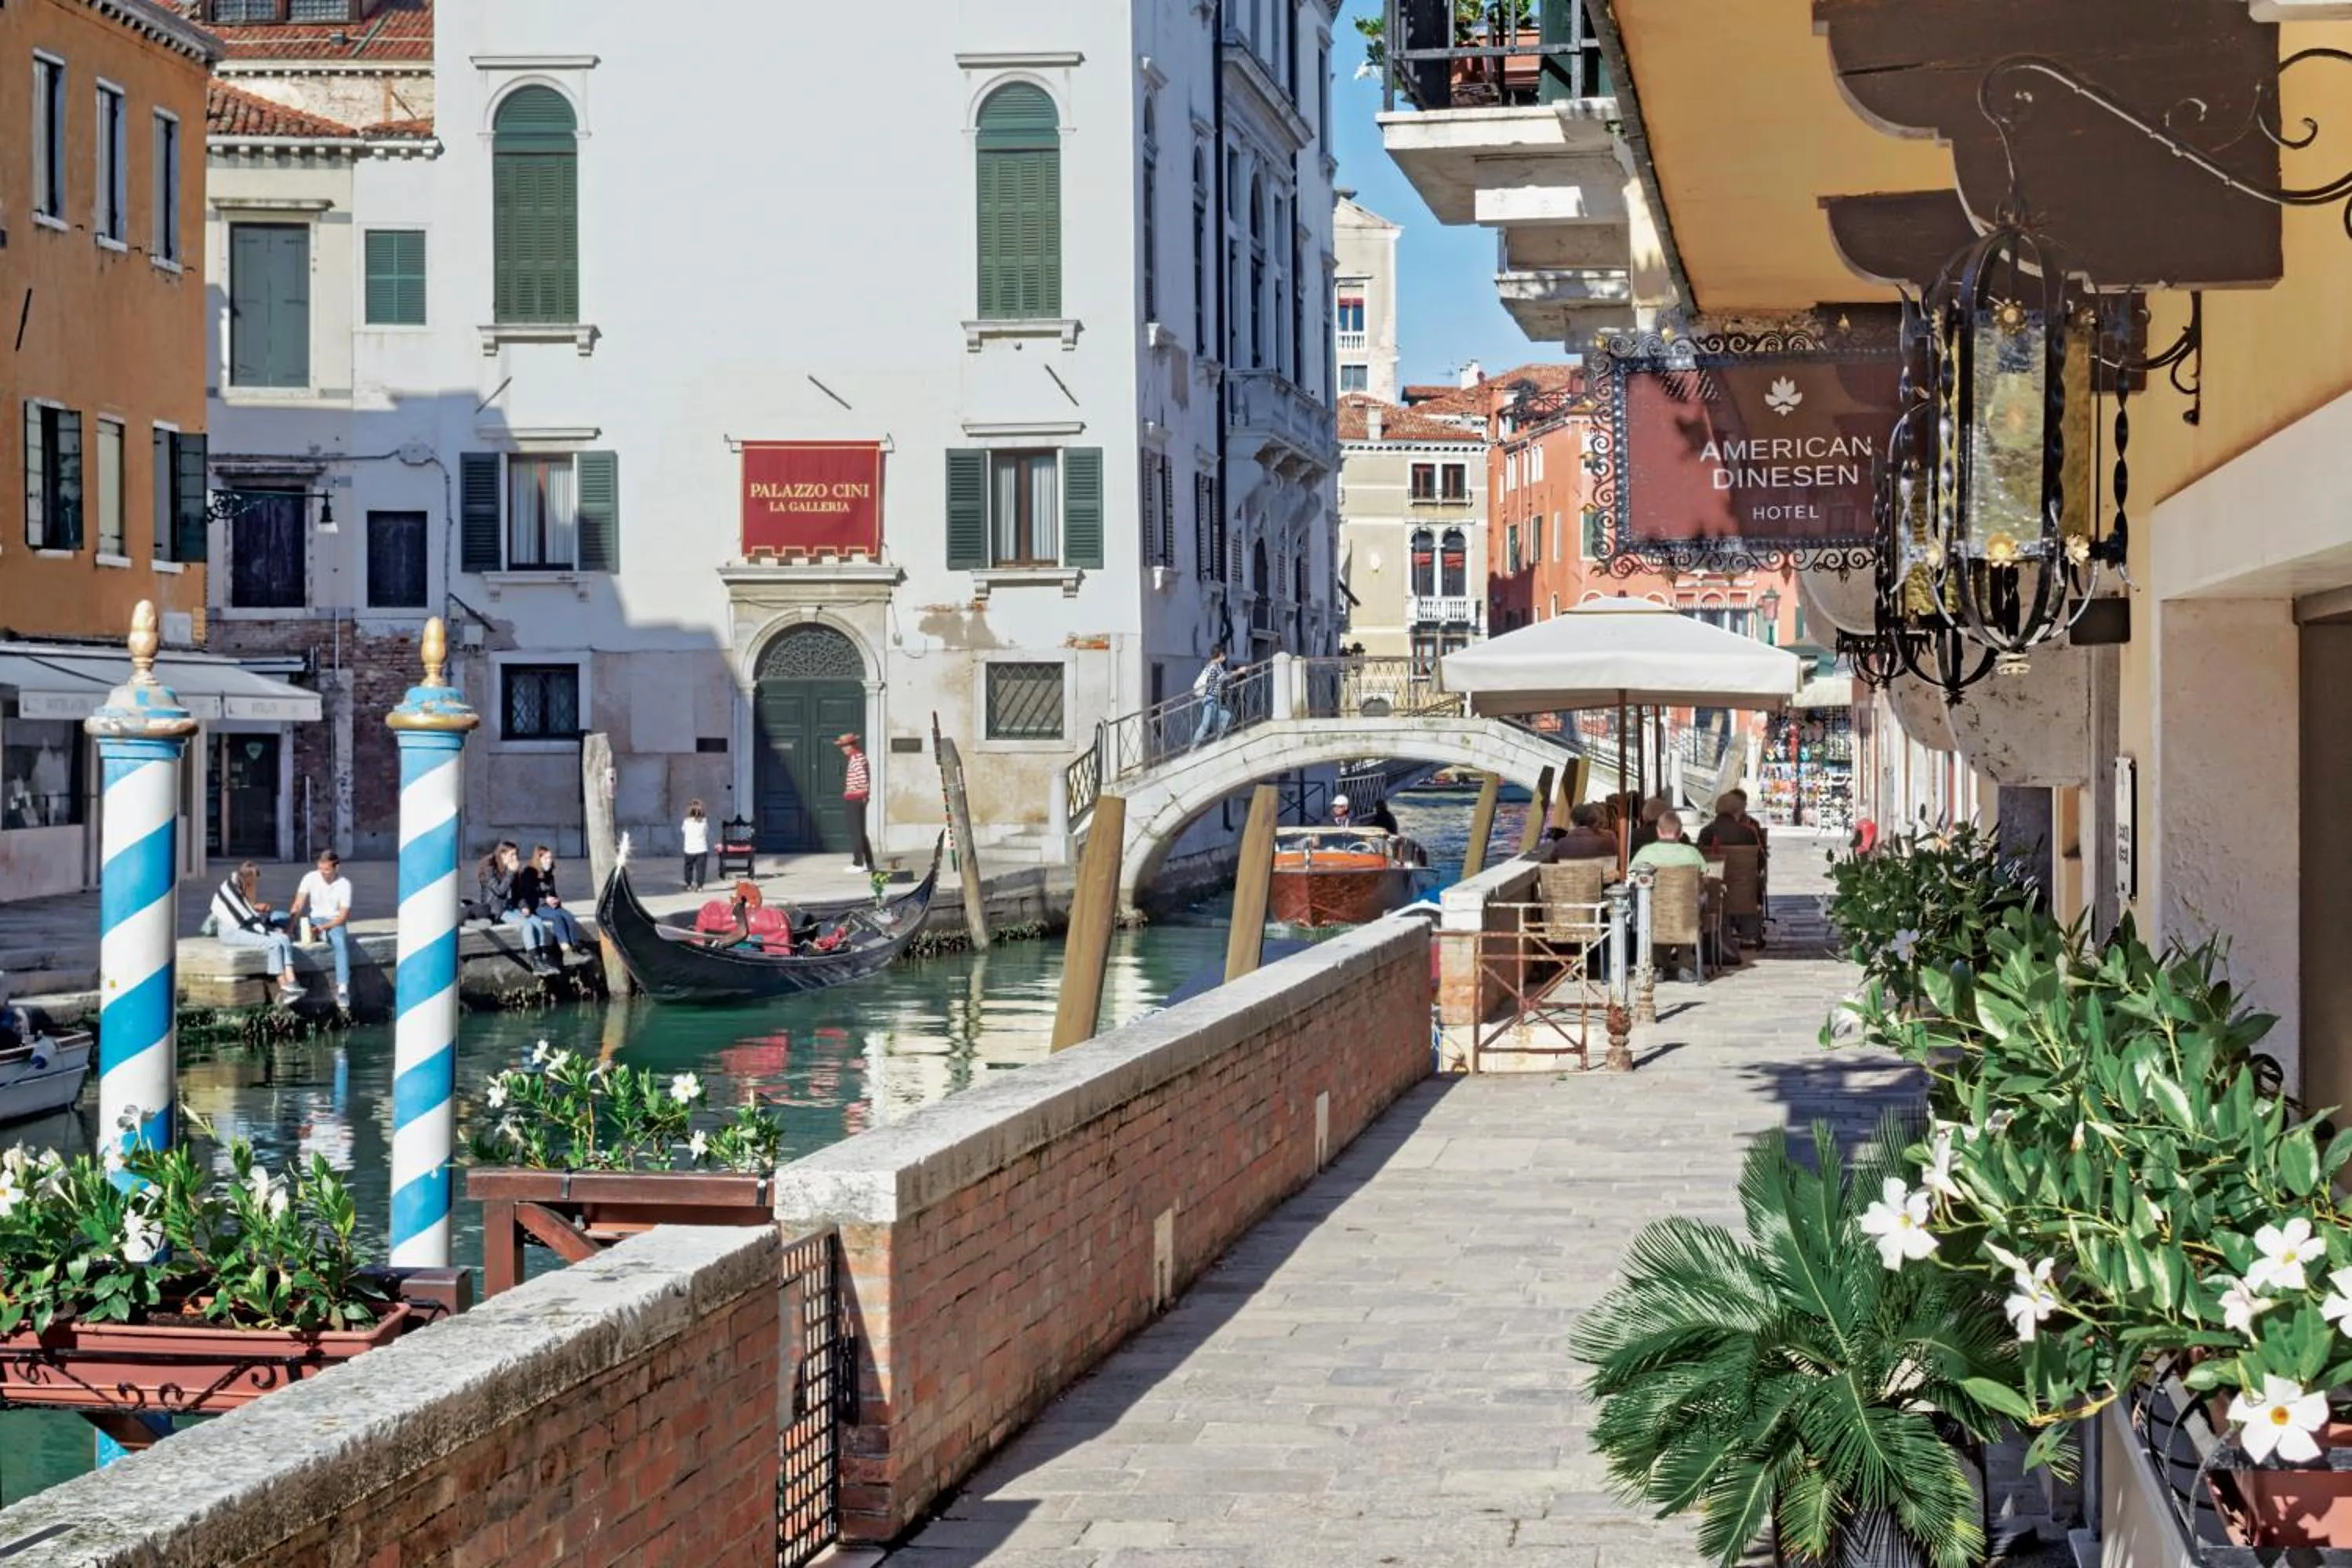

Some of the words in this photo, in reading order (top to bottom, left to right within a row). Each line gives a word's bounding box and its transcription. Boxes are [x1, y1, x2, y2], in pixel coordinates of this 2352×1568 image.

[1700, 436, 1872, 462] AMERICAN
[1713, 465, 1858, 491] DINESEN
[750, 483, 828, 498] PALAZZO
[832, 483, 869, 498] CINI
[769, 501, 786, 512] LA
[789, 501, 850, 512] GALLERIA
[1752, 505, 1820, 521] HOTEL
